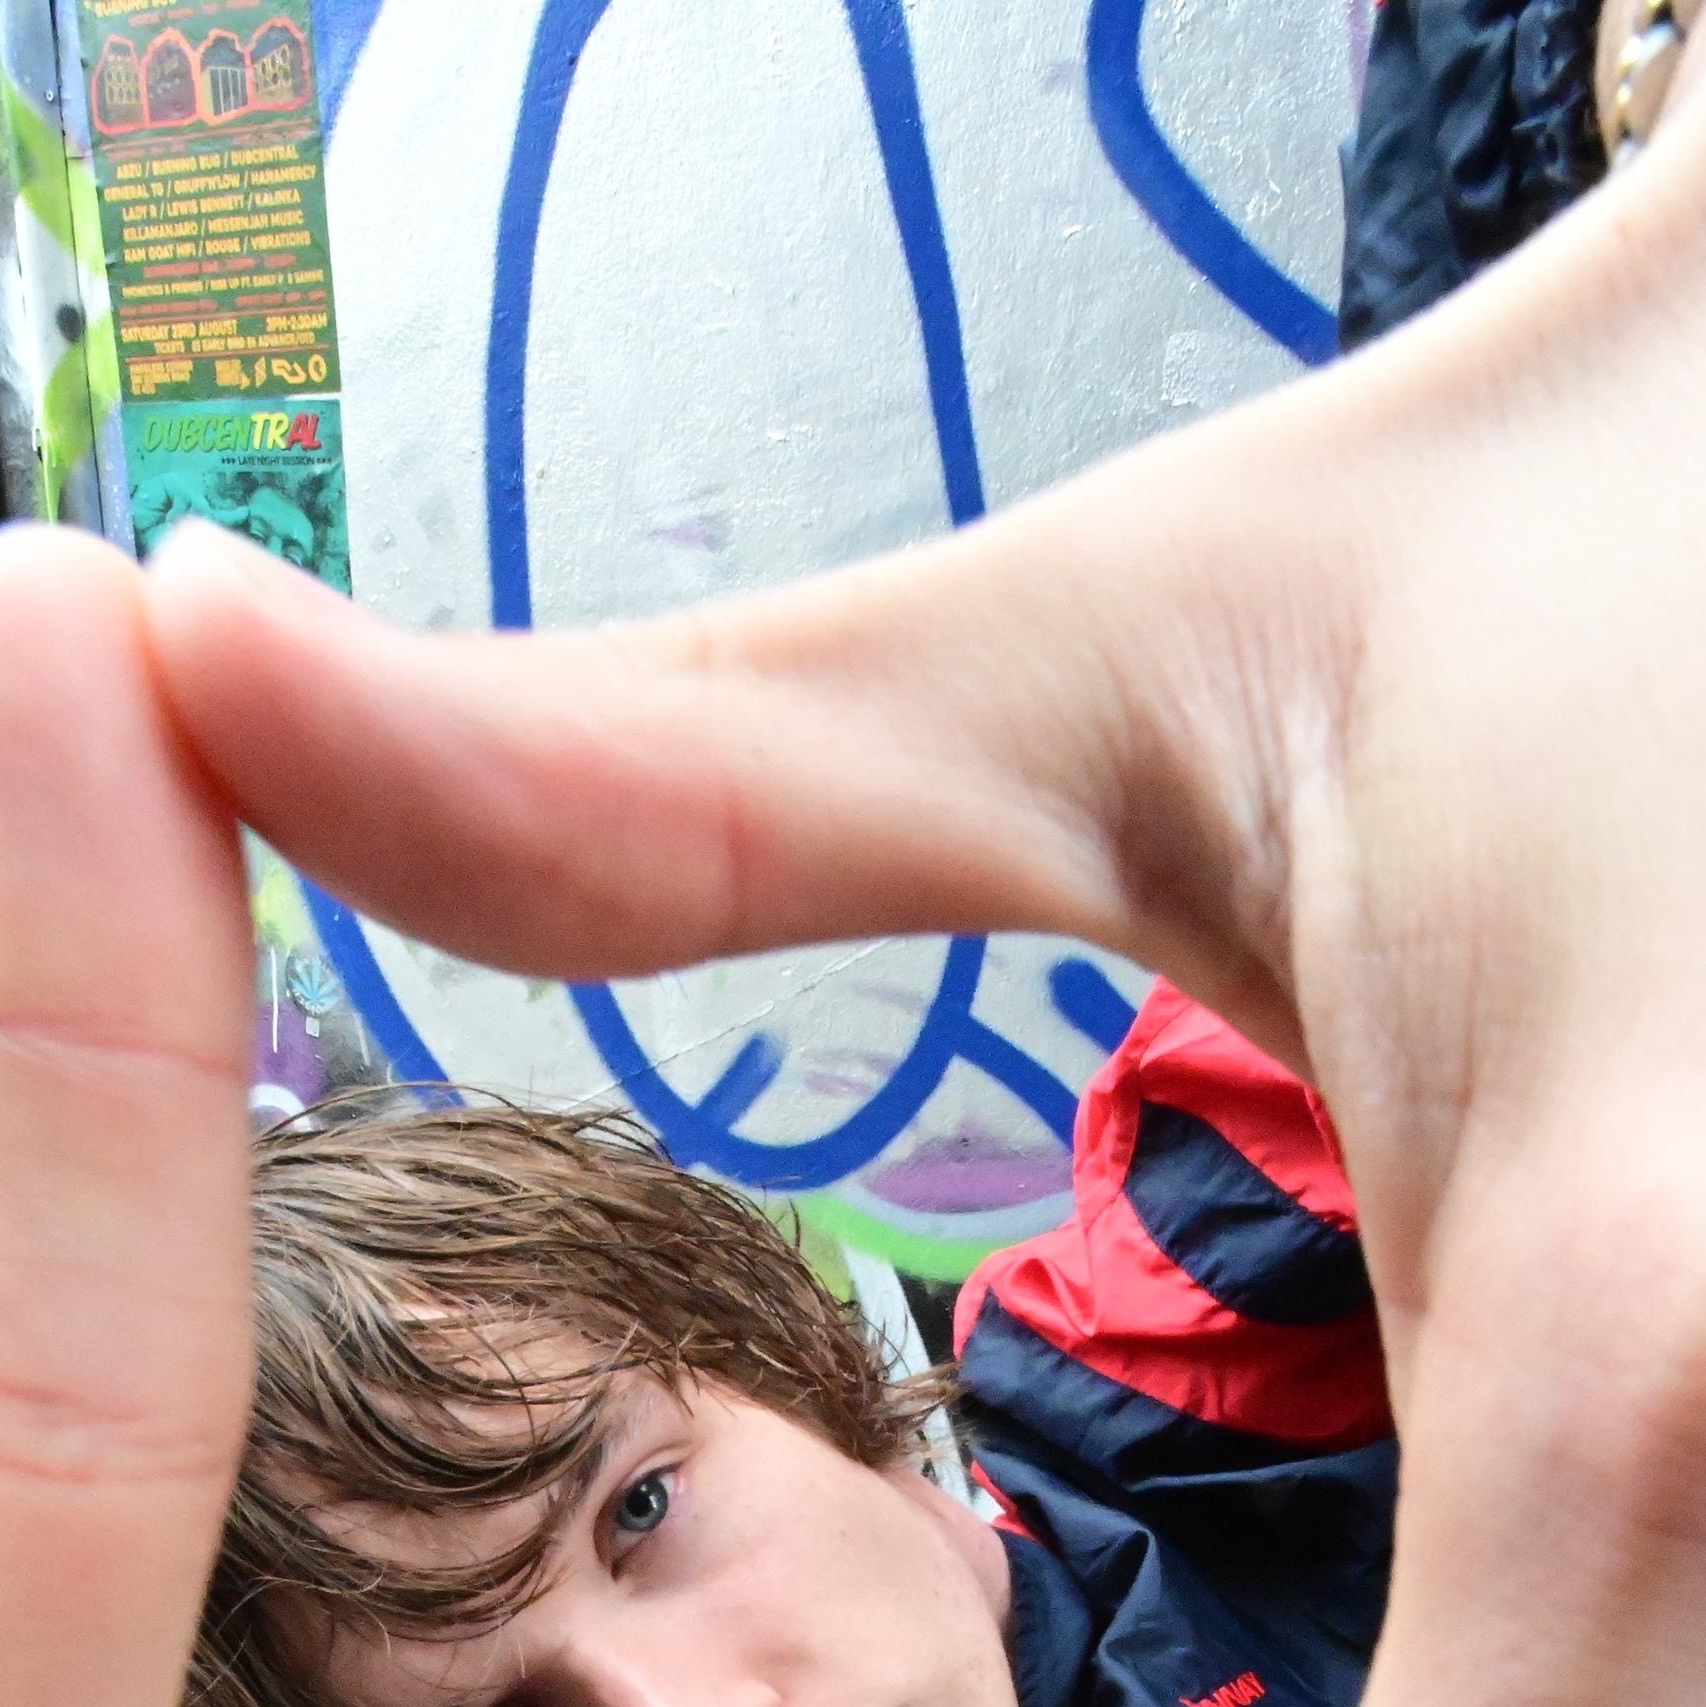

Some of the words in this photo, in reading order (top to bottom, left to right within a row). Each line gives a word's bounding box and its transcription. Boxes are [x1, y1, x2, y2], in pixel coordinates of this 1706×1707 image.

[230, 145, 299, 166] DUBCENTRAL
[122, 205, 147, 222] LADY
[271, 209, 304, 226] MUSIC
[148, 244, 173, 261] GOAT
[121, 325, 169, 342] SATURDAY
[199, 319, 237, 336] AUGUST
[146, 411, 322, 452] DUBCENTRAL
[256, 456, 280, 466] NIGHT
